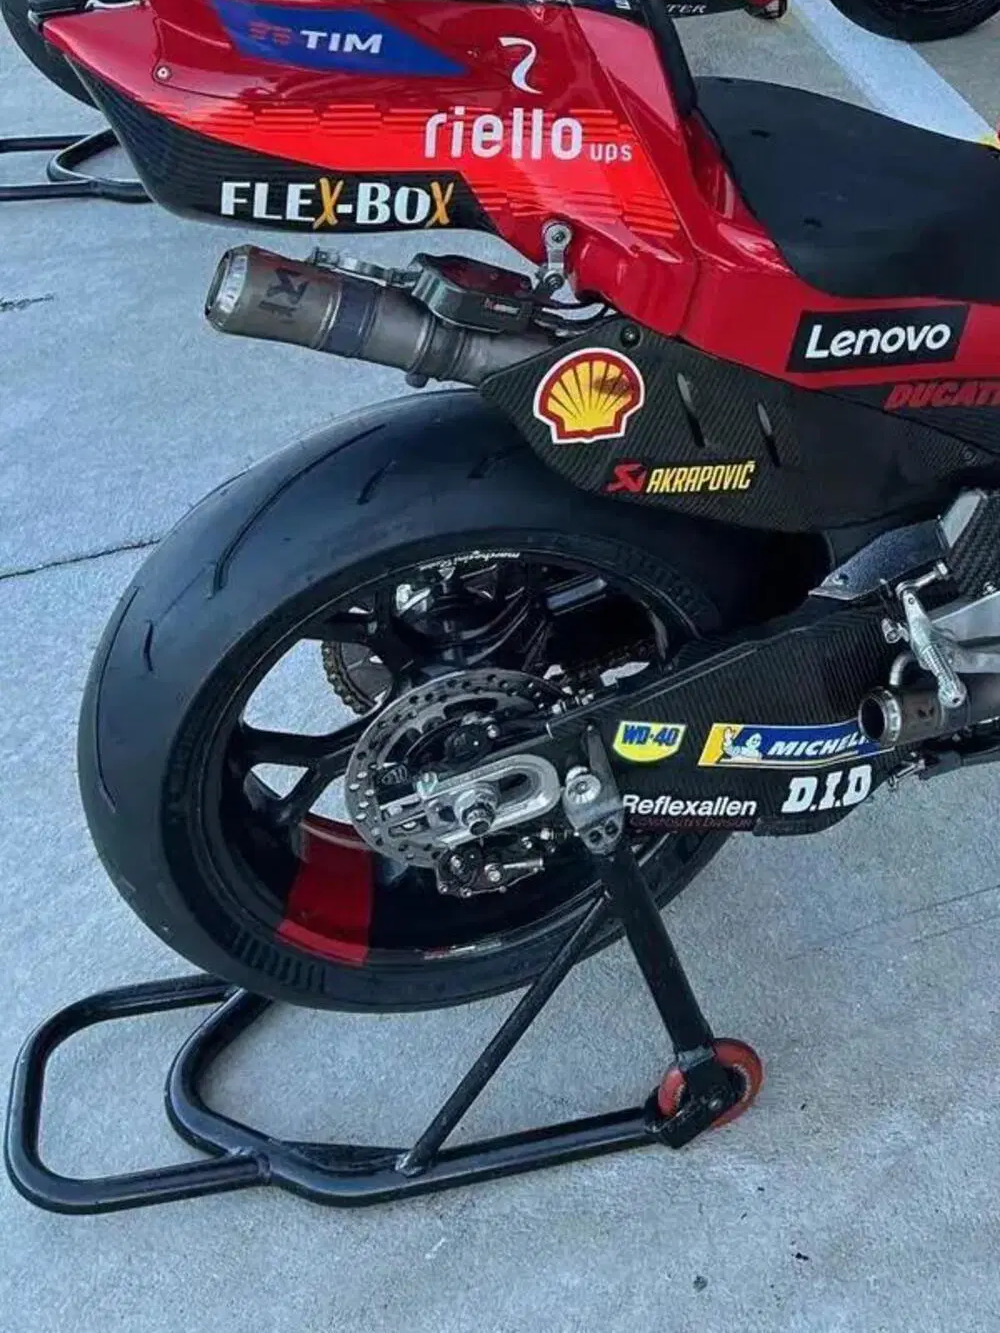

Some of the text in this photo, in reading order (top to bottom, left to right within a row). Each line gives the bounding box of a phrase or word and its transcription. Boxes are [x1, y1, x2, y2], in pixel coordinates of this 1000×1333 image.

[301, 29, 384, 54] TIM
[423, 106, 633, 162] riello ups
[220, 176, 455, 230] FLEX-BOX
[804, 323, 951, 359] Lenovo
[645, 460, 757, 494] AKRAPOVIČ
[622, 725, 679, 746] WD-40
[767, 731, 870, 757] MICHELI
[623, 793, 757, 817] Reflexallen
[781, 765, 873, 813] D.I.D
